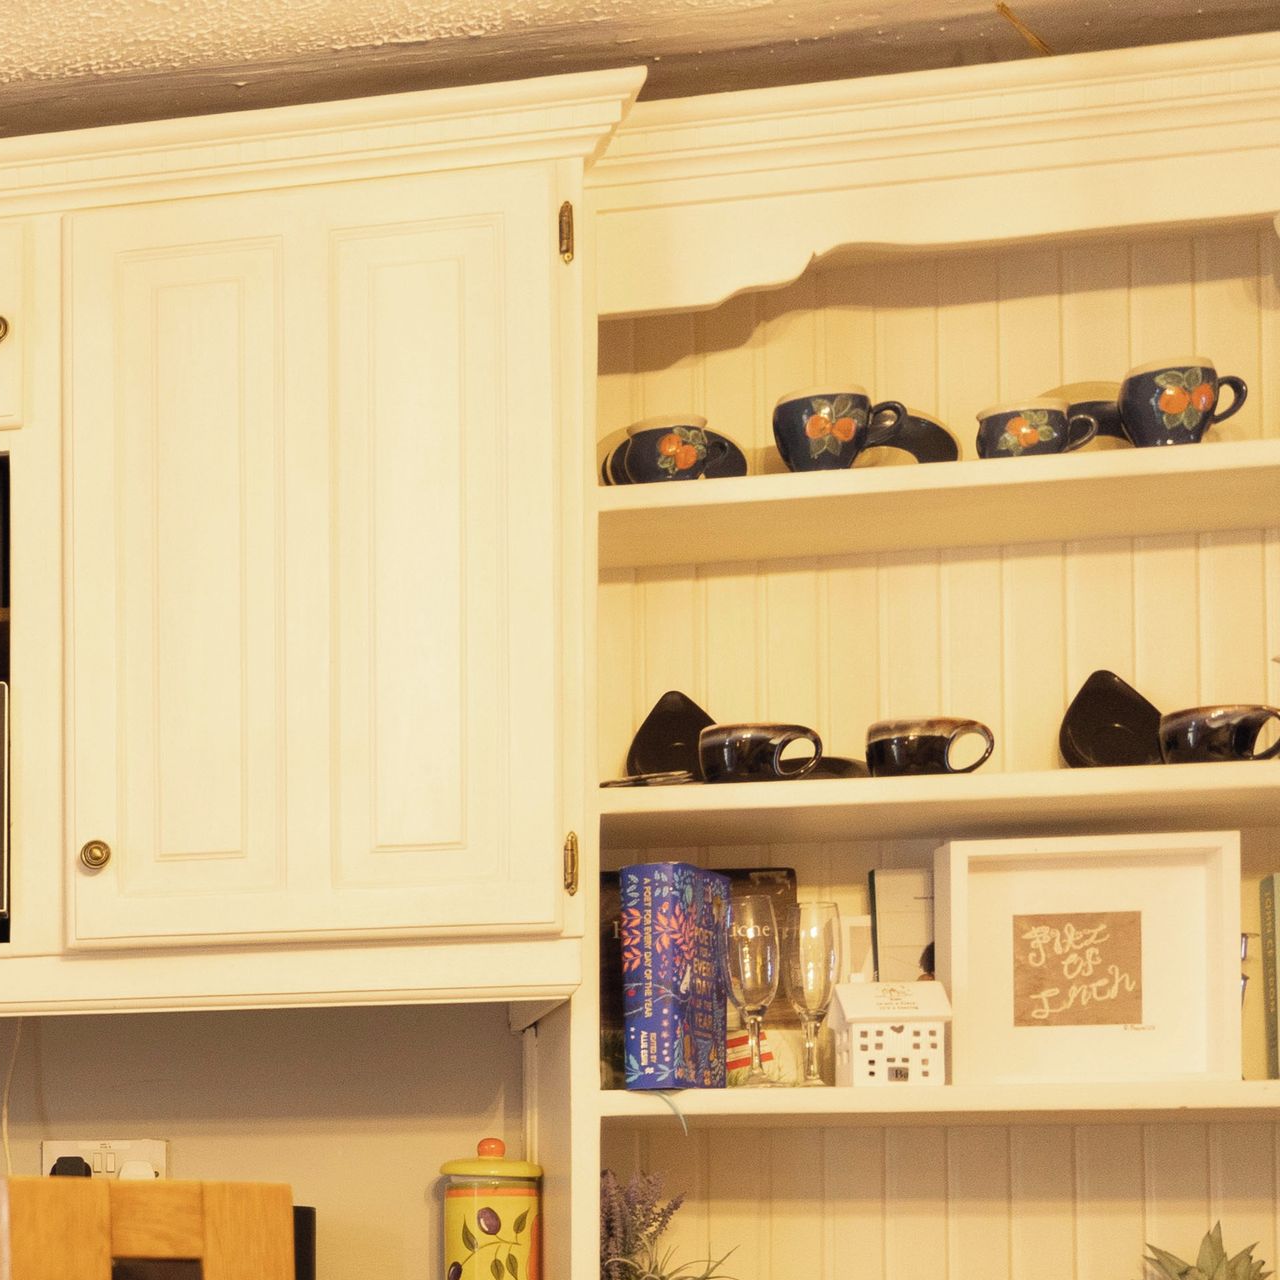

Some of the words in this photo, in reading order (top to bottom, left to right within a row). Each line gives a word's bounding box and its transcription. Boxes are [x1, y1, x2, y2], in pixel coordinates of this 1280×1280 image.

[643, 877, 652, 885] A
[643, 886, 653, 907] POET
[643, 908, 653, 926] FOR
[643, 926, 653, 950] EVERY
[643, 951, 653, 968] DAY
[643, 968, 653, 980] OF
[643, 981, 653, 997] THE
[643, 997, 653, 1018] YEAR
